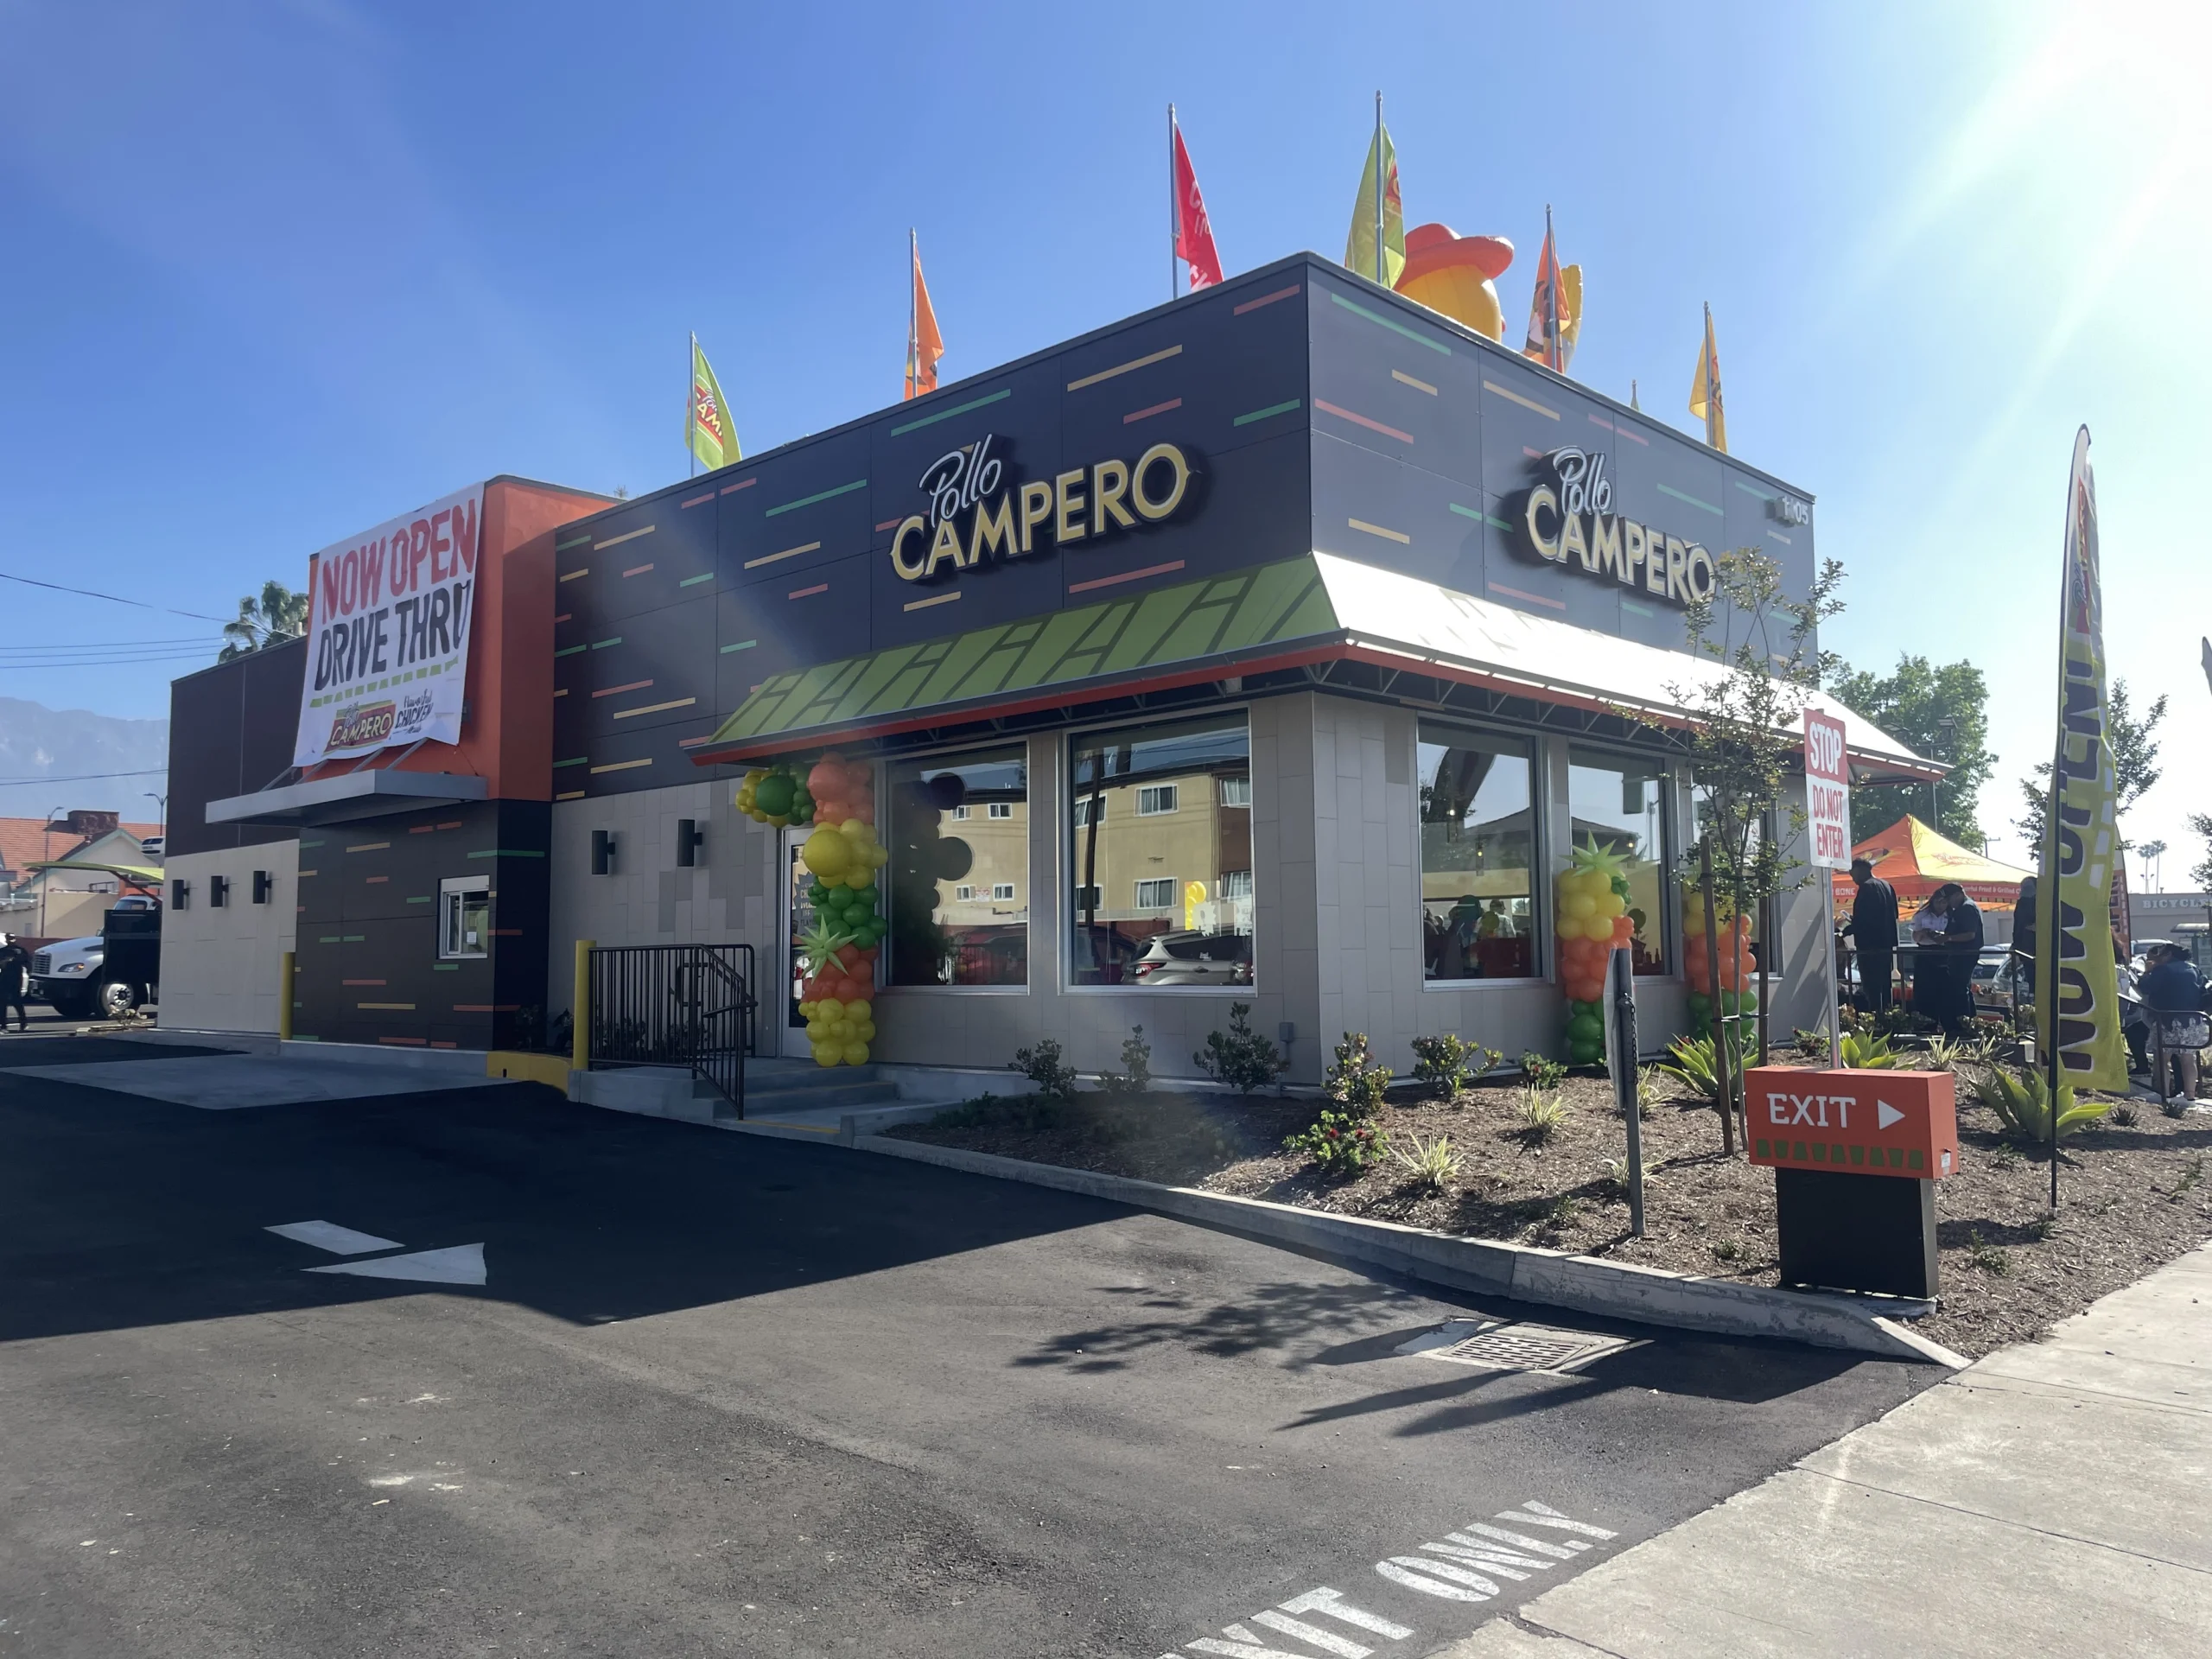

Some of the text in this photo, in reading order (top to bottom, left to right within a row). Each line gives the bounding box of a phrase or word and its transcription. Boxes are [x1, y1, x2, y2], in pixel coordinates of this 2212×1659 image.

[890, 442, 1191, 581] CAMPERO
[919, 434, 1001, 528] Pollo
[1553, 447, 1611, 517] Pollo
[322, 499, 476, 625] NOW OPEN
[1525, 485, 1716, 607] CAMPERO
[314, 579, 472, 691] DRIVE THRU
[330, 713, 392, 746] CAMPERO
[1809, 721, 1842, 775] STOP
[1813, 785, 1843, 823] DO NOT
[1817, 823, 1845, 860] ENTER
[1767, 1093, 1856, 1128] EXIT
[1376, 1500, 1619, 1602] ONLY
